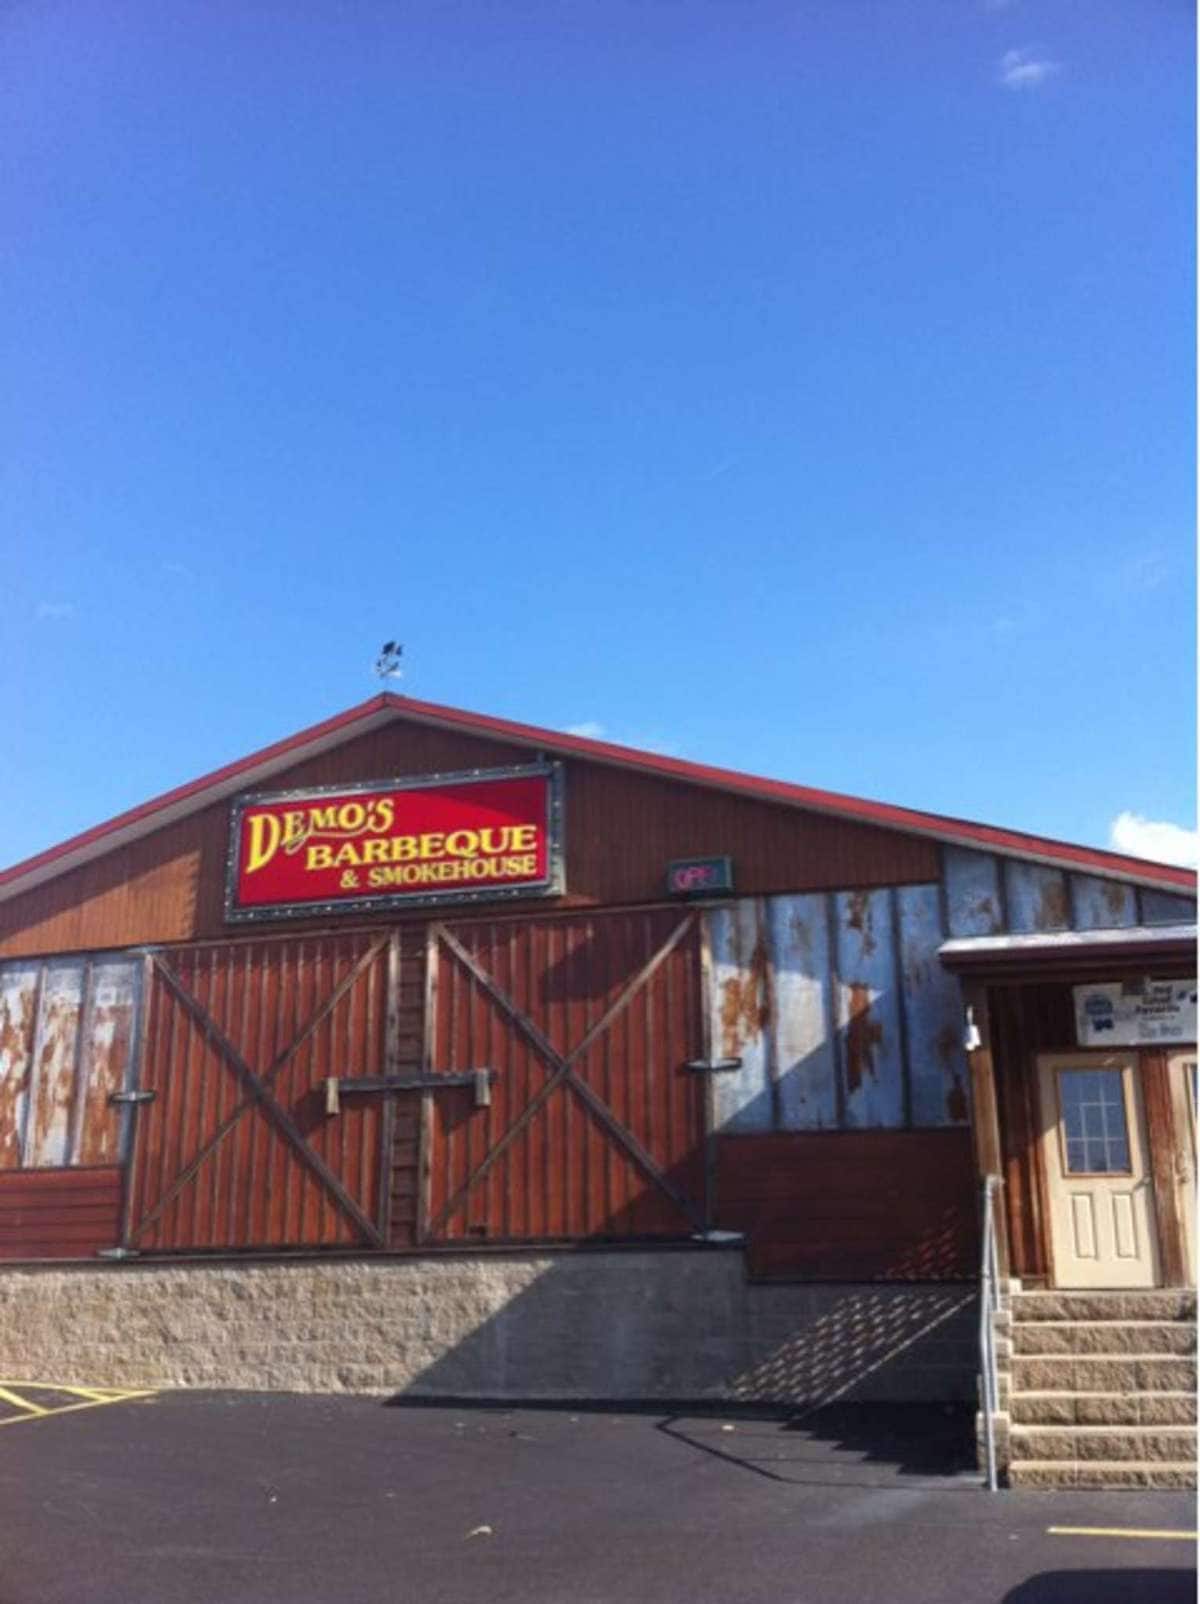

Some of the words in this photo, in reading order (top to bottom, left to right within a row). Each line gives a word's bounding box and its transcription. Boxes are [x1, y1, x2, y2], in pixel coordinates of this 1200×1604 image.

[246, 799, 394, 874] DEMO'S
[306, 825, 537, 870] BARBEQUE
[339, 872, 359, 889] &
[368, 854, 535, 888] SMOKEHOUSE
